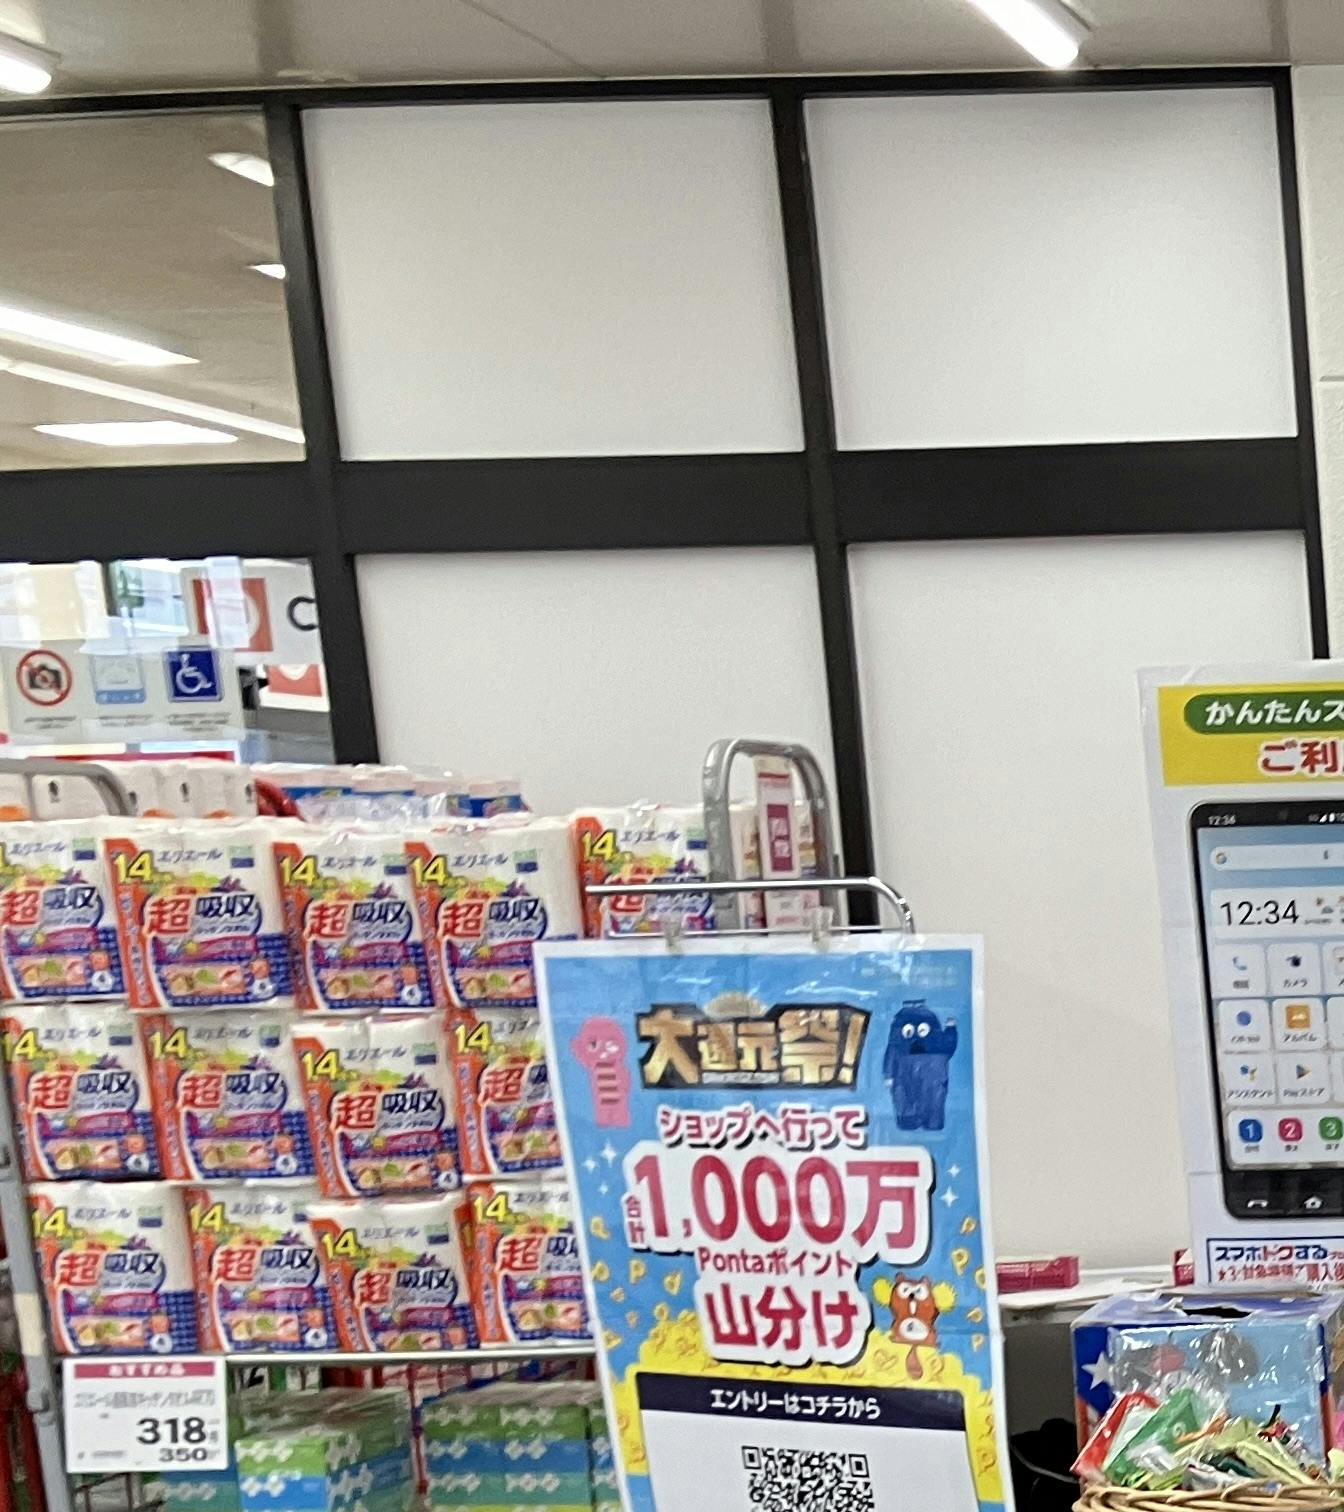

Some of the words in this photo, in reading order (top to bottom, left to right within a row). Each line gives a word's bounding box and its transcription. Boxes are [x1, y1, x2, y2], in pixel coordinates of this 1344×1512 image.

[582, 829, 619, 862] 14
[114, 851, 152, 886] 14
[280, 855, 318, 888] 14
[409, 855, 450, 887] 14
[1, 887, 96, 926] 超吸収
[150, 894, 255, 934] 超吸収
[308, 900, 405, 938] 超吸収
[442, 899, 540, 938] 超吸収
[1220, 899, 1300, 927] 12:34
[1, 1028, 38, 1061] 14
[150, 1027, 189, 1060] 14
[455, 1021, 493, 1053] 14
[301, 1050, 340, 1082] 14
[32, 1072, 131, 1110] 超吸収
[182, 1072, 281, 1110] 超吸収
[335, 1090, 439, 1130] 超吸収
[659, 1106, 864, 1148] ショップへ行って
[190, 1201, 226, 1232] 14
[474, 1191, 510, 1223] 14
[624, 1194, 646, 1246] 合計
[633, 1154, 923, 1252] 1,000万
[32, 1206, 69, 1239] 14
[321, 1227, 359, 1259] 14
[58, 1251, 160, 1287] 超吸収
[215, 1248, 316, 1283] 超吸収
[699, 1247, 855, 1279] Pontaポイント
[356, 1269, 451, 1306] 超吸収
[703, 1282, 861, 1352] 山分け
[709, 1387, 881, 1421] エントリーはコチラから
[136, 1416, 207, 1445] 318
[159, 1447, 208, 1462] 350
